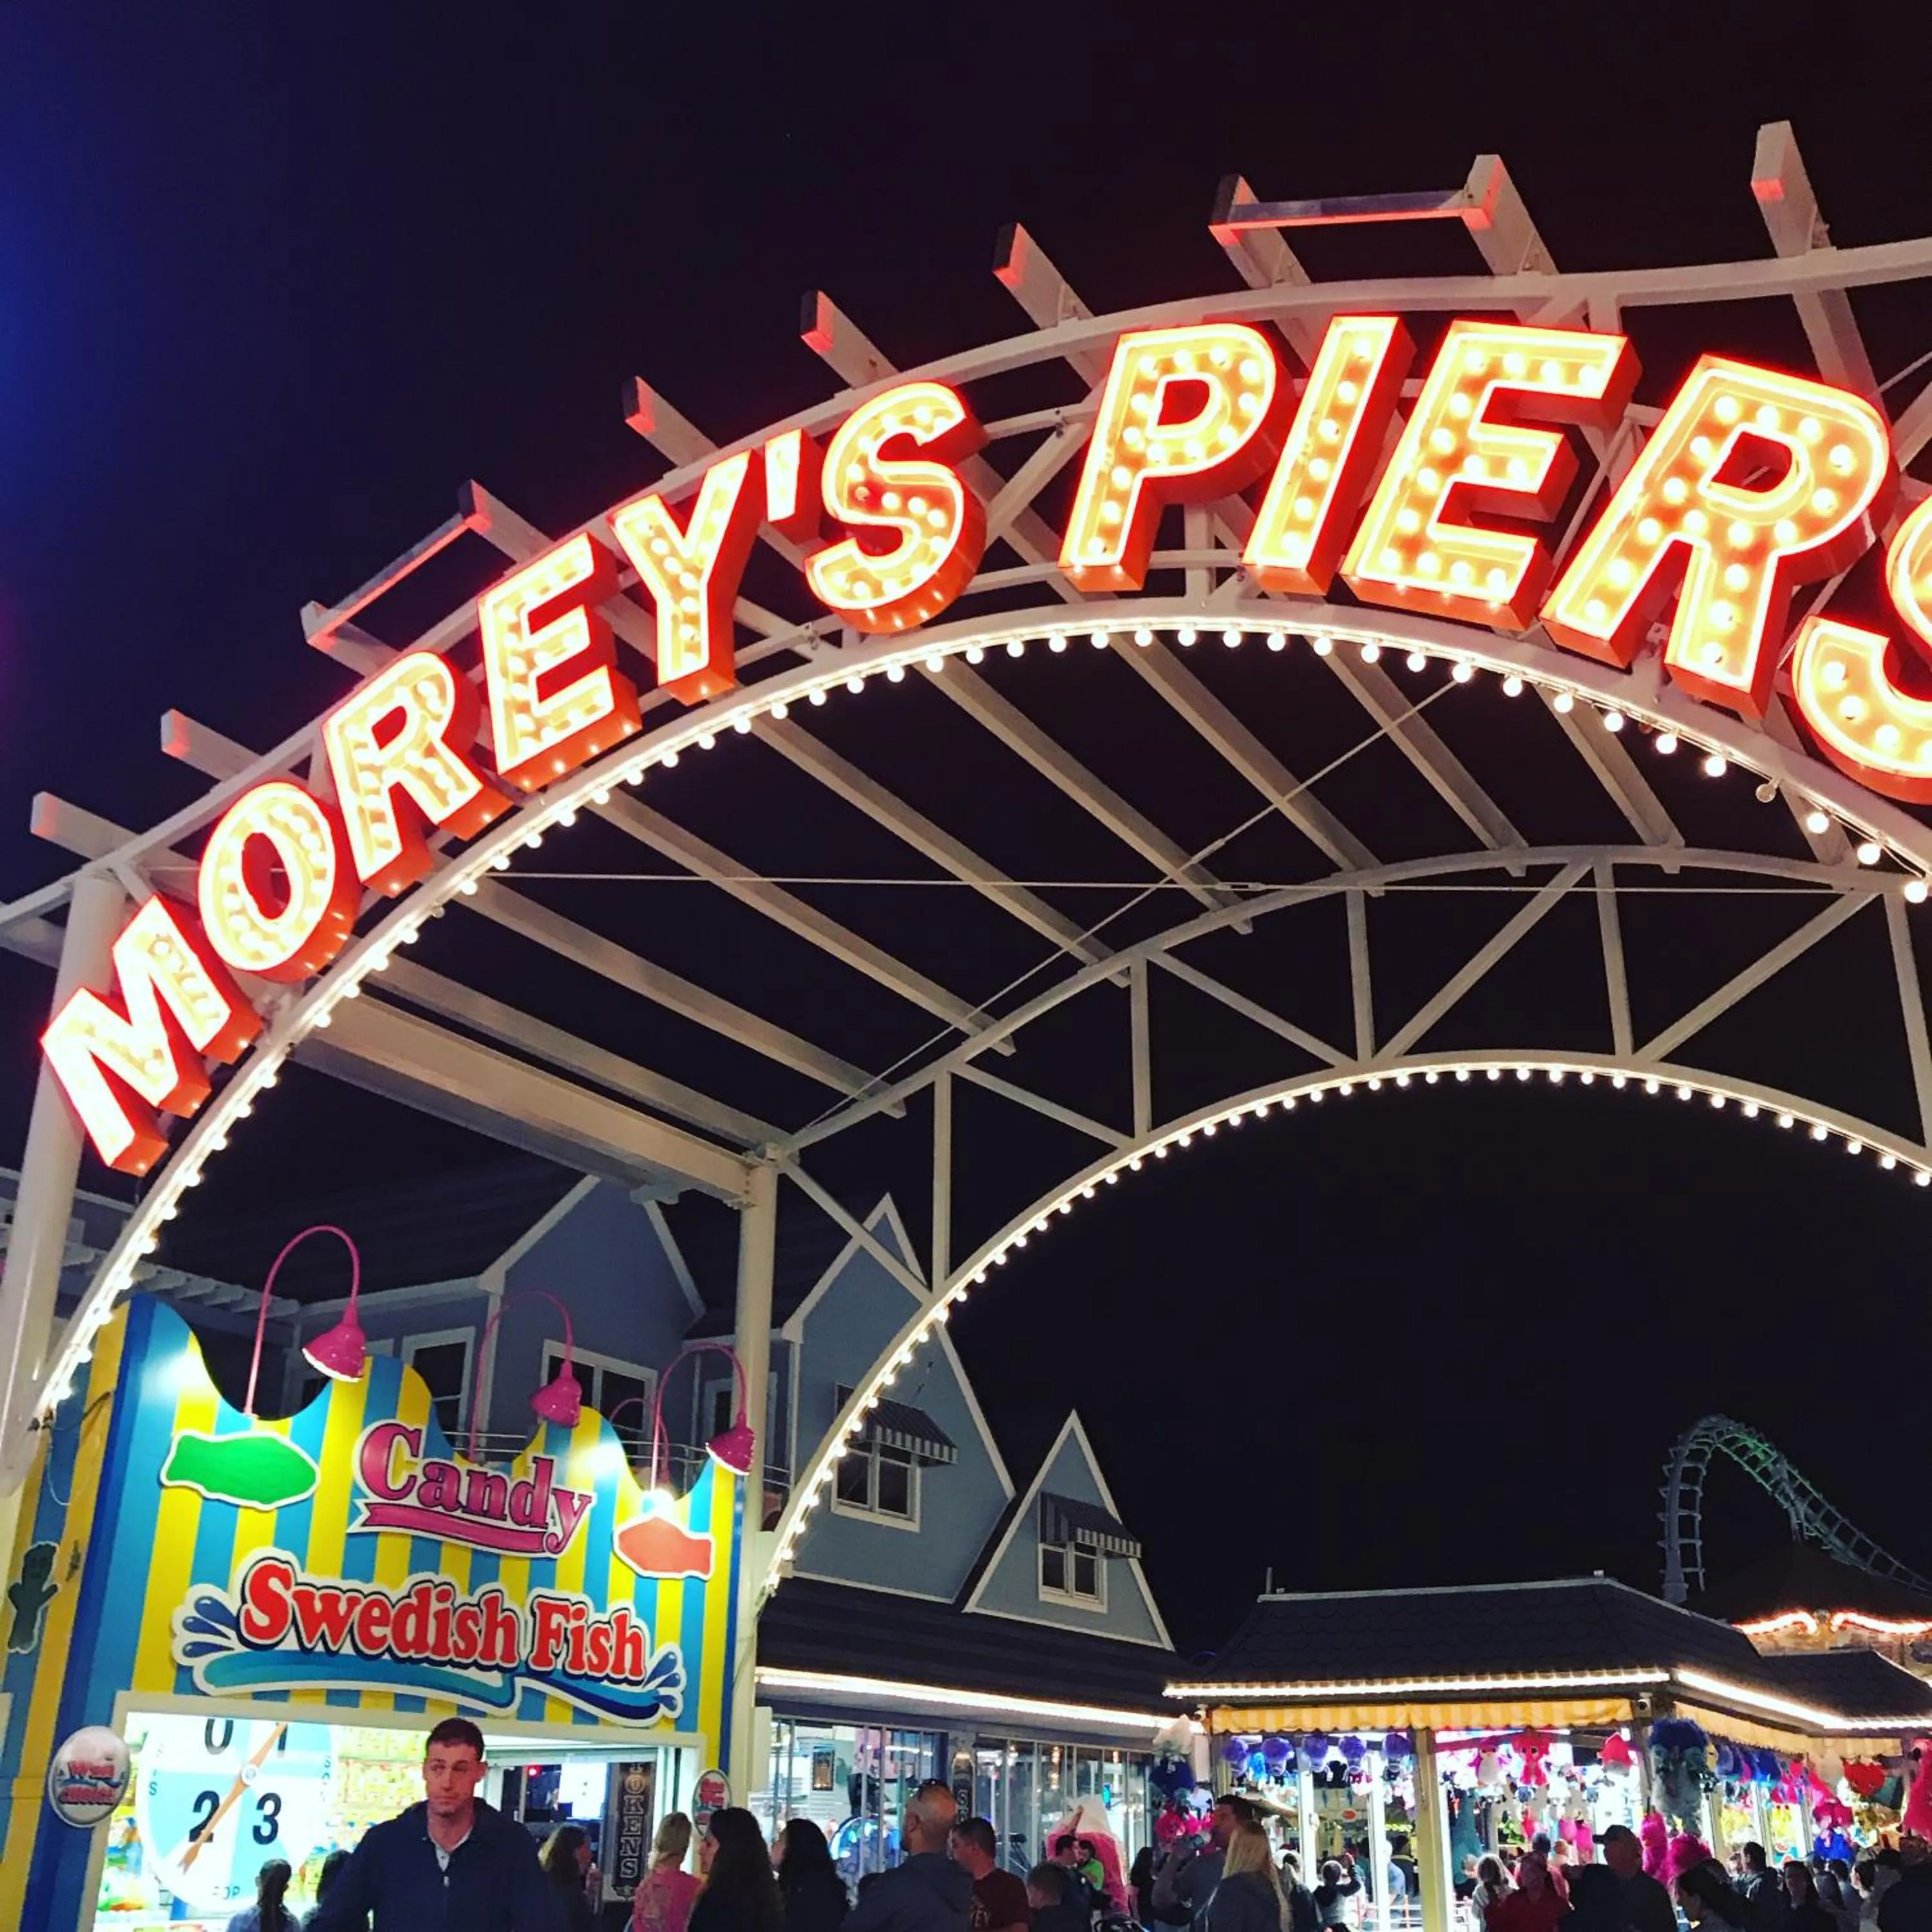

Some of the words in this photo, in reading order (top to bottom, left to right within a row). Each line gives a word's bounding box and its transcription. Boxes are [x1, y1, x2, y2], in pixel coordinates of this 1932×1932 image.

[40, 379, 984, 1175] MOREY'S
[359, 1422, 594, 1555] Candy
[241, 1558, 520, 1669] Swedish
[530, 1598, 648, 1681] Fish
[189, 1790, 220, 1842] 2
[252, 1792, 282, 1845] 3
